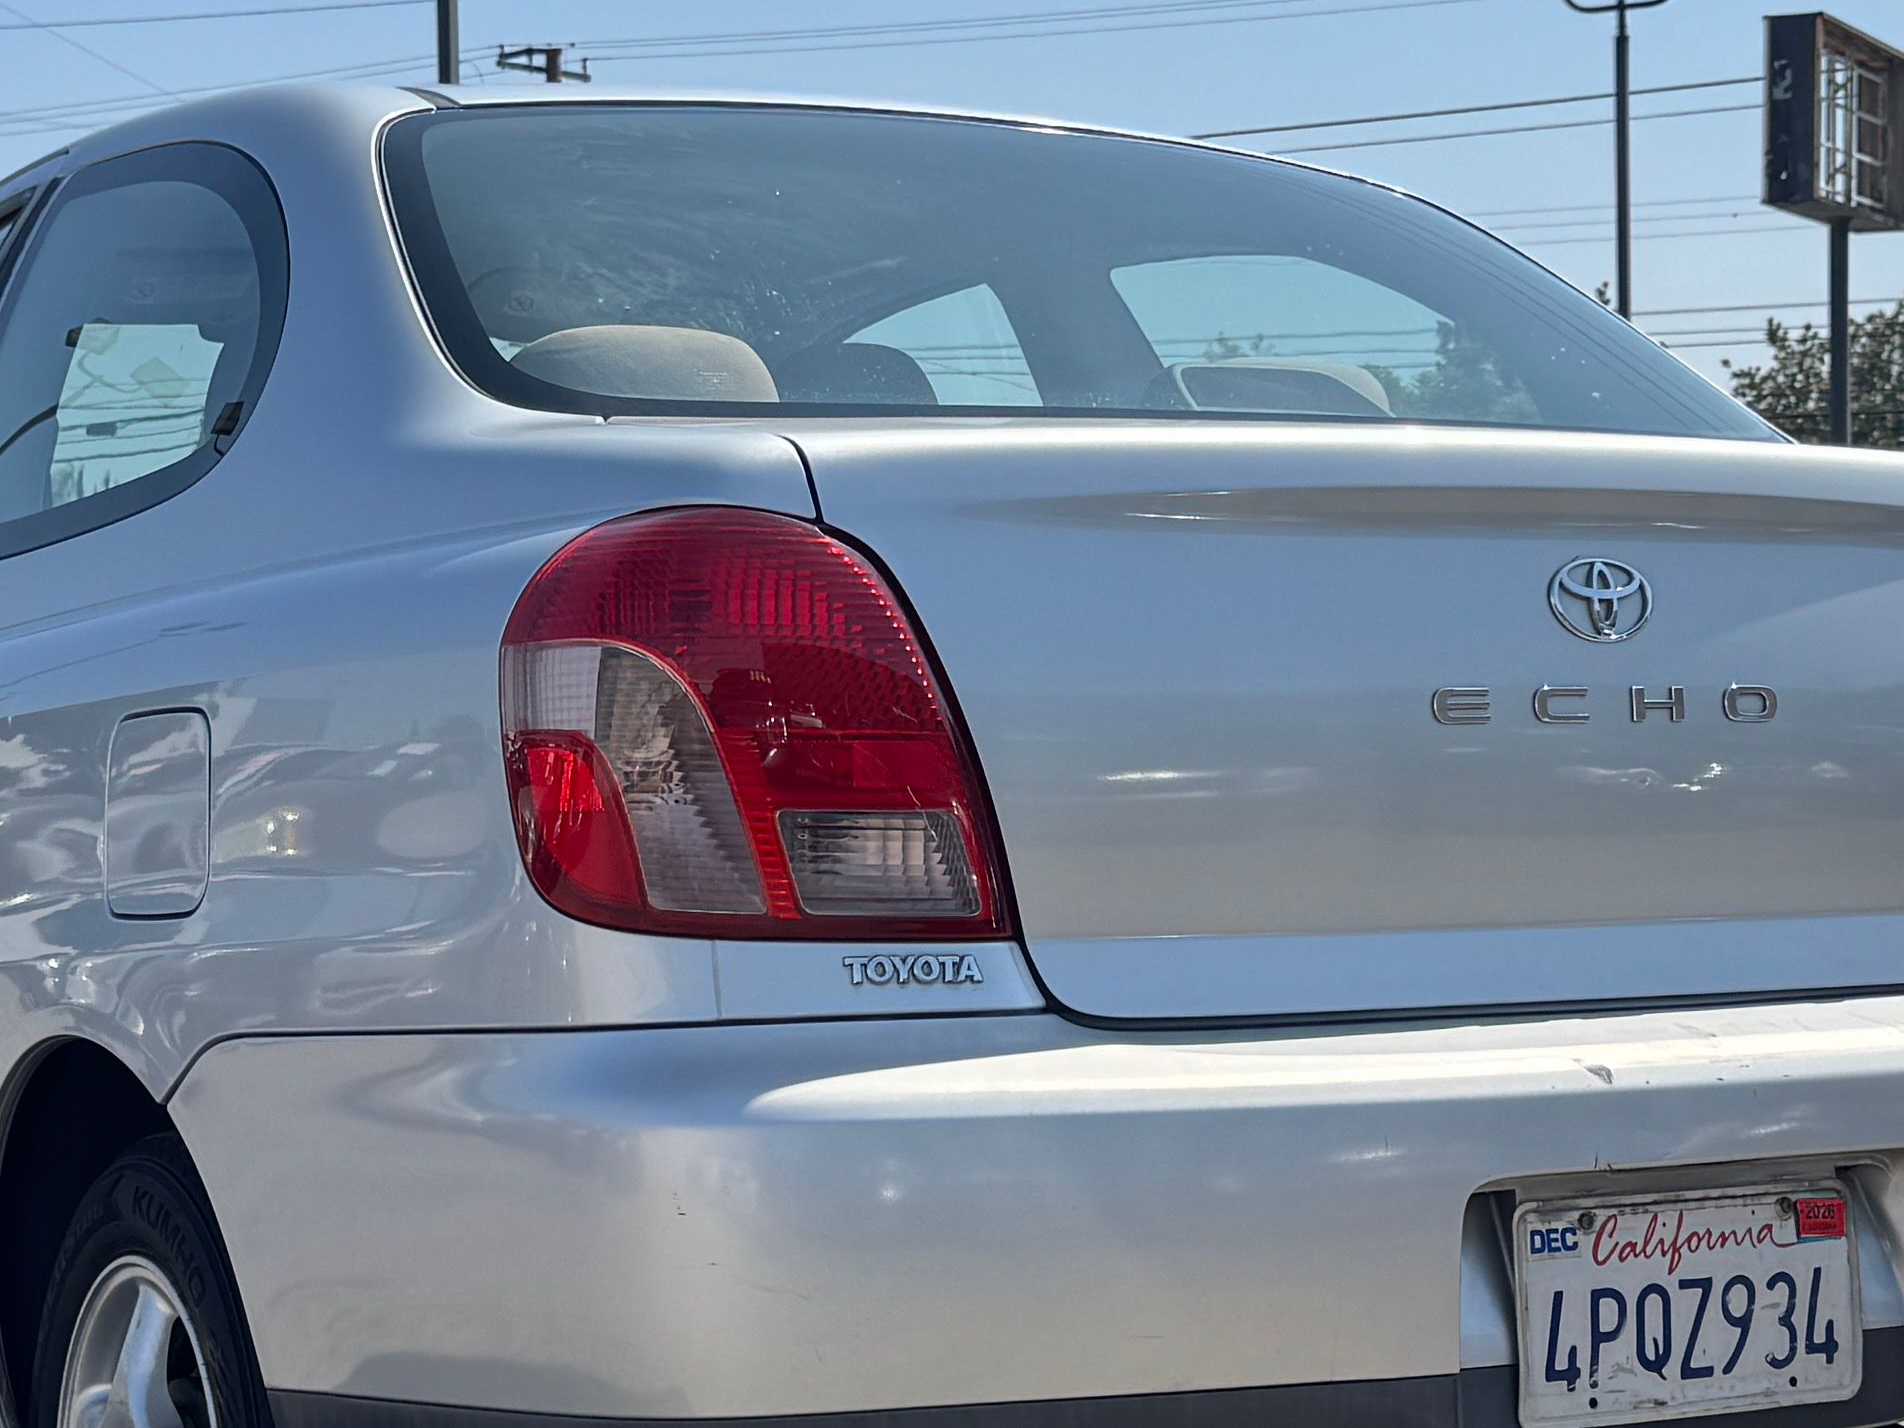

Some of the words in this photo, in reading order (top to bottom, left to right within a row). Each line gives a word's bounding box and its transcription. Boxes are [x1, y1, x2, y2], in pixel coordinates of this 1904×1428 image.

[1432, 683, 1778, 725] ECHO
[843, 954, 984, 985] TOYOTA
[1806, 1203, 1836, 1220] 2026
[1529, 1226, 1579, 1255] DEC
[1592, 1209, 1798, 1276] California
[1545, 1266, 1839, 1392] 4PQZ934
